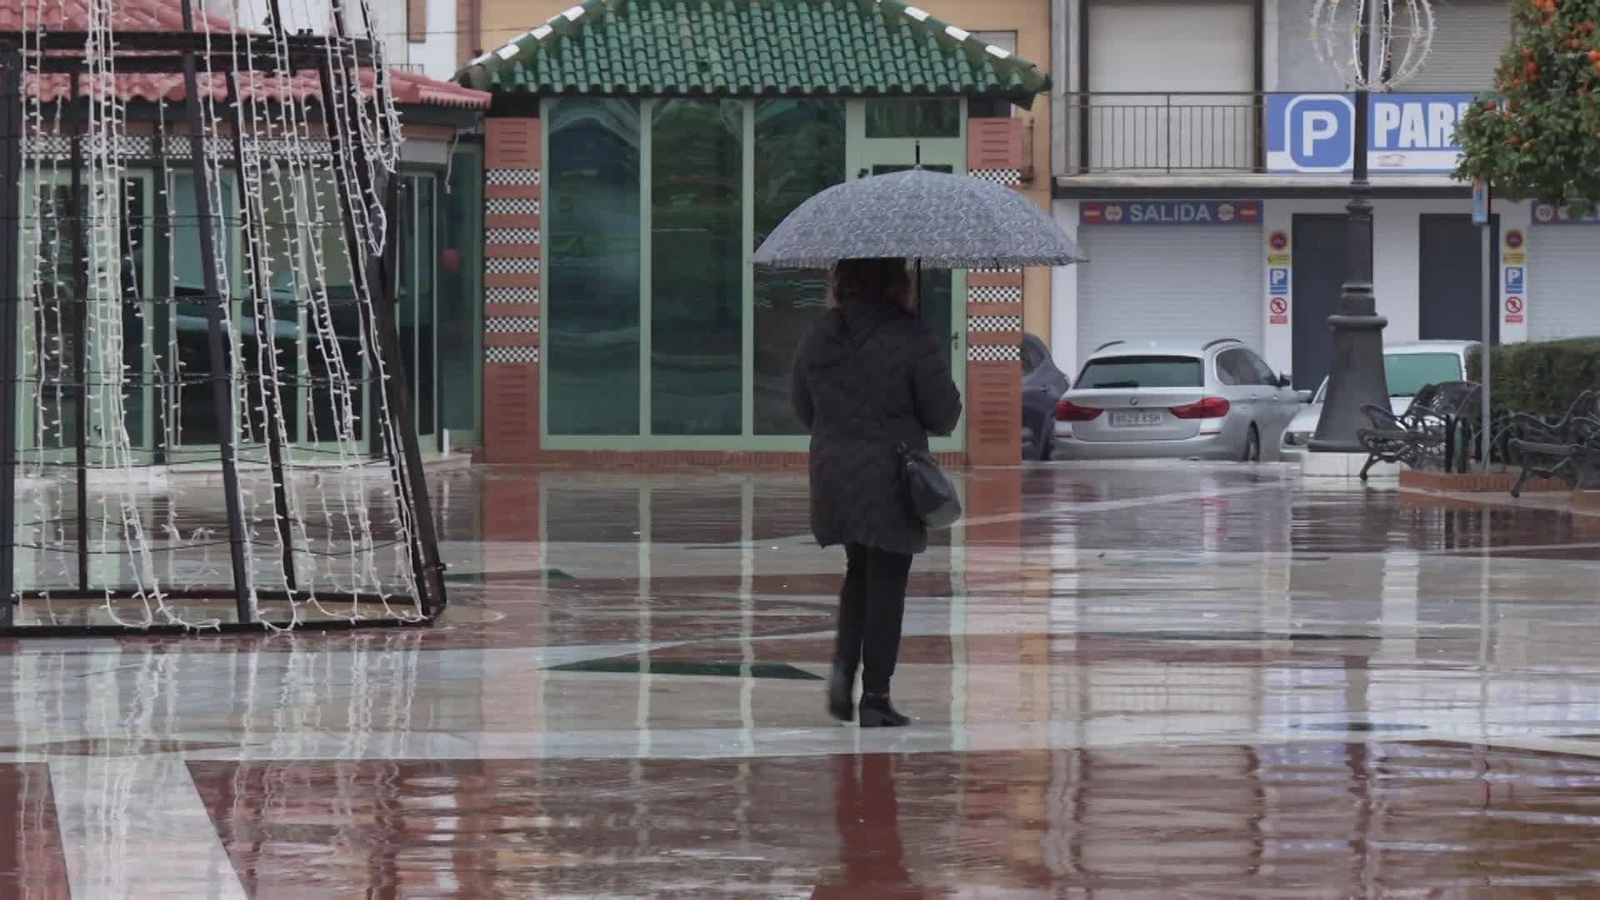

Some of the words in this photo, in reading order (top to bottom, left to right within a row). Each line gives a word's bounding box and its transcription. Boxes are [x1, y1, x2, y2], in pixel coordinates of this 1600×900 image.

[1374, 102, 1469, 148] PAR
[1303, 111, 1339, 157] P
[1130, 204, 1212, 221] SALIDA
[1272, 269, 1285, 285] P
[1508, 268, 1521, 283] P
